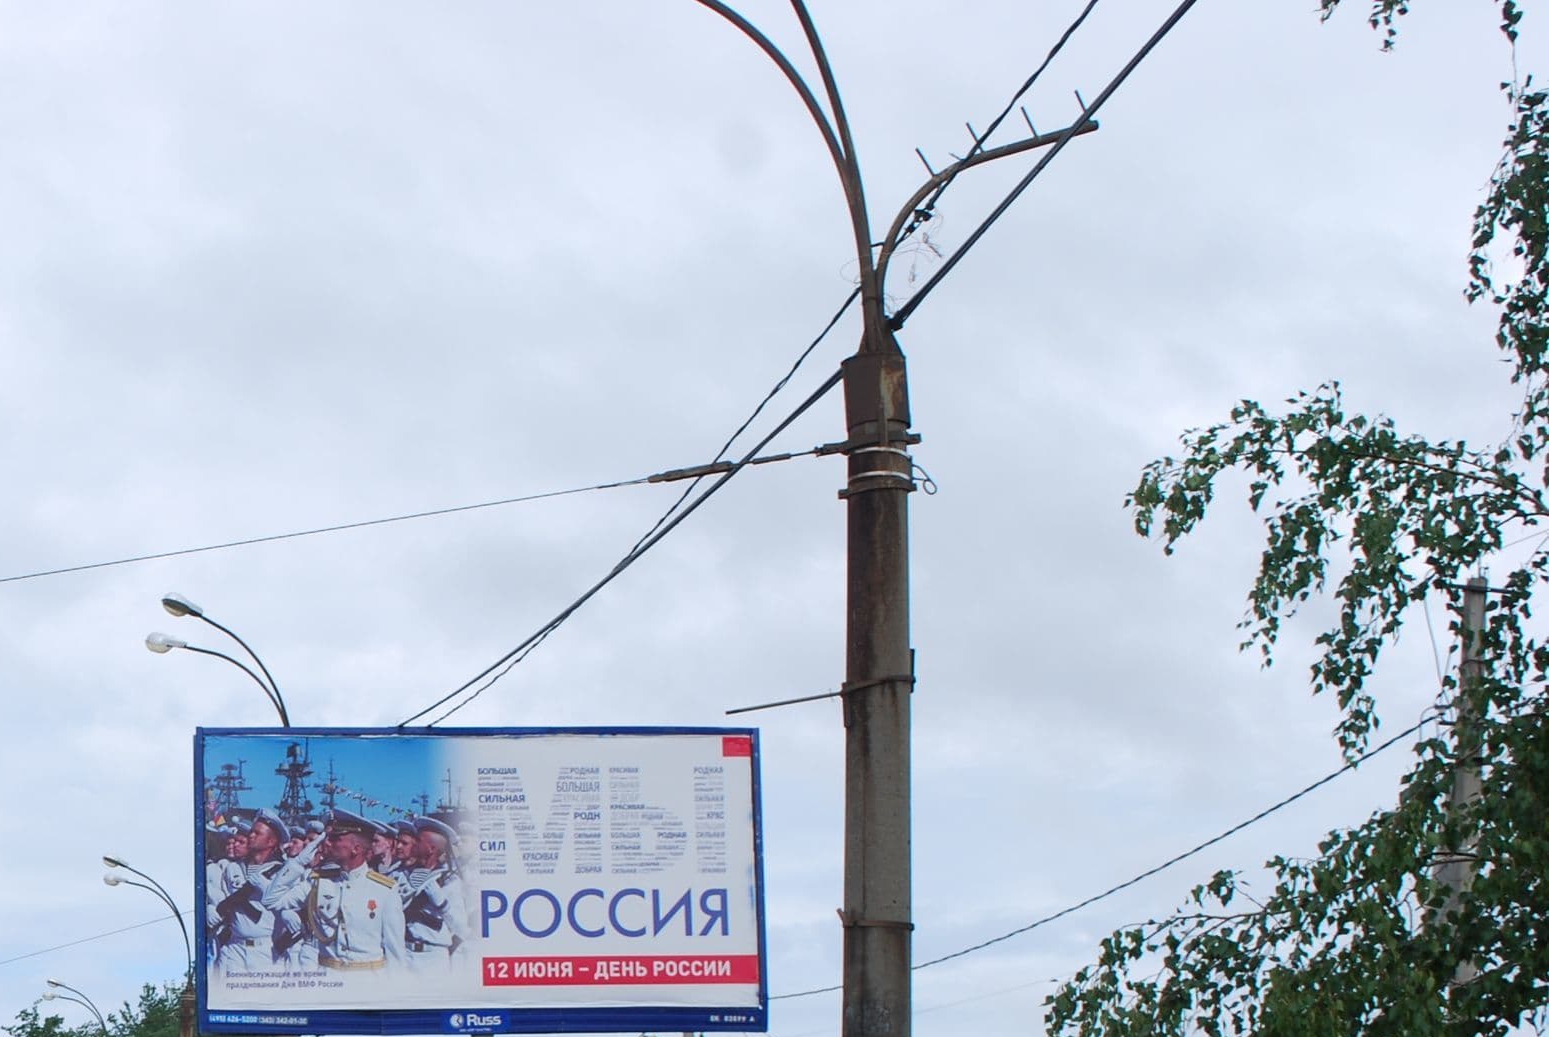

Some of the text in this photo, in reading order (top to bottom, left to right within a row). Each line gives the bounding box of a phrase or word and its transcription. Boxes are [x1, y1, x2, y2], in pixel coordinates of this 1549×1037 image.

[477, 767, 517, 775] БОЛЬШАЯ
[556, 781, 600, 792] БОЛЬШАЯ
[478, 794, 526, 803] СИЛЬНАЯ
[574, 811, 601, 820] РОДН
[479, 841, 506, 852] СИЛ
[481, 888, 730, 938] РОССИЯ
[487, 962, 508, 979] 12
[514, 962, 574, 978] ИЮНЯ
[594, 961, 648, 980] ДЕНЬ
[653, 960, 731, 977] РОССИИ
[466, 1013, 503, 1026] Russ
